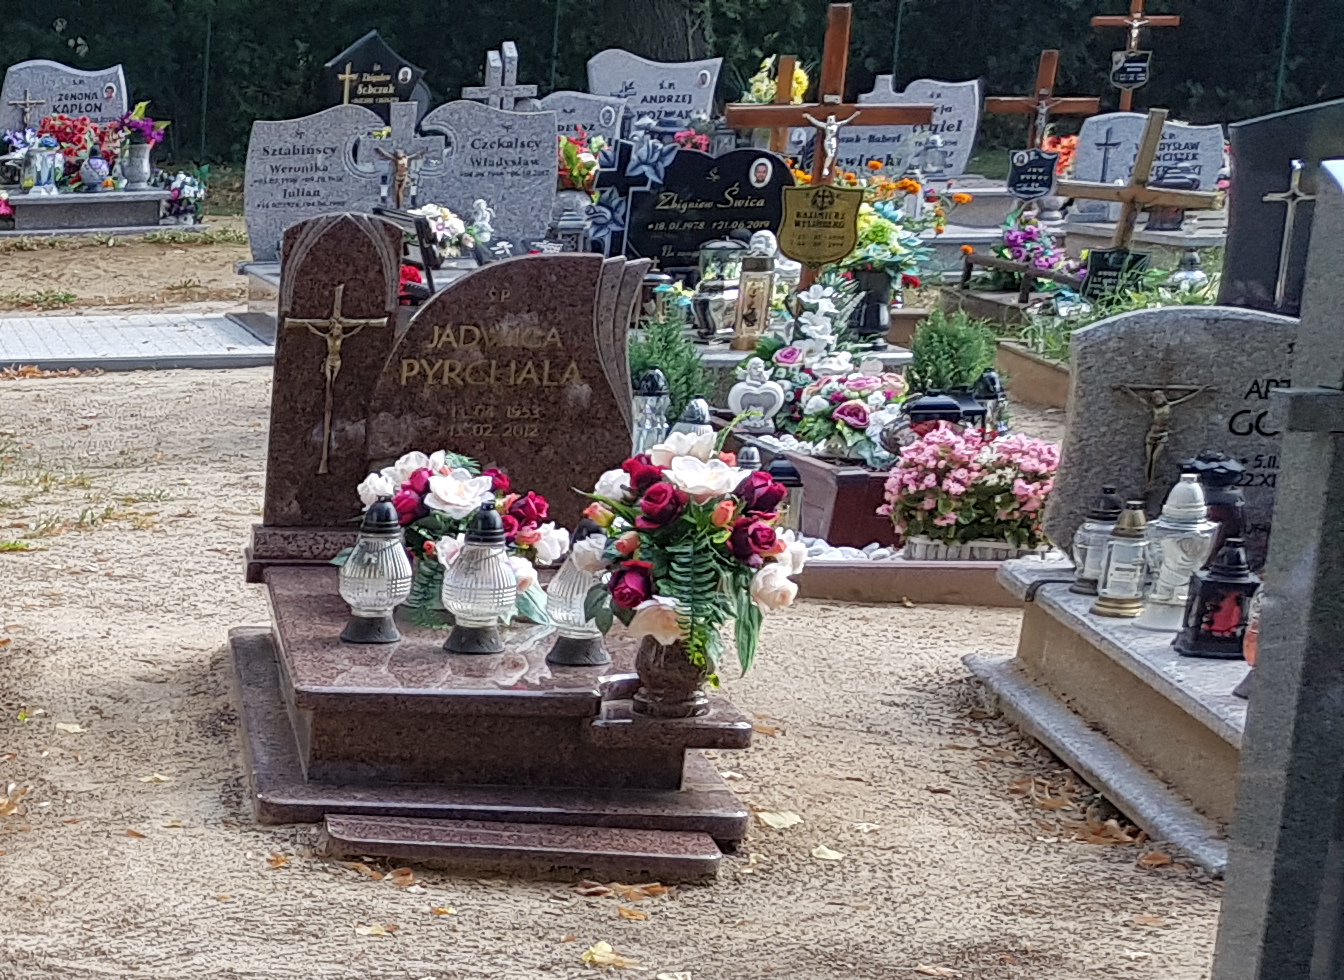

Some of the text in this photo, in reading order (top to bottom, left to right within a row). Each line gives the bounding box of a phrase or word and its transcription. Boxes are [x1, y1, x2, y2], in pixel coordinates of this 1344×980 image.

[640, 94, 693, 104] ANDRZEJ
[262, 144, 339, 156] Sztabińscy
[282, 188, 321, 199] Julian
[655, 182, 766, 214] Zbigniew Świca
[426, 324, 563, 349] JADWIGA
